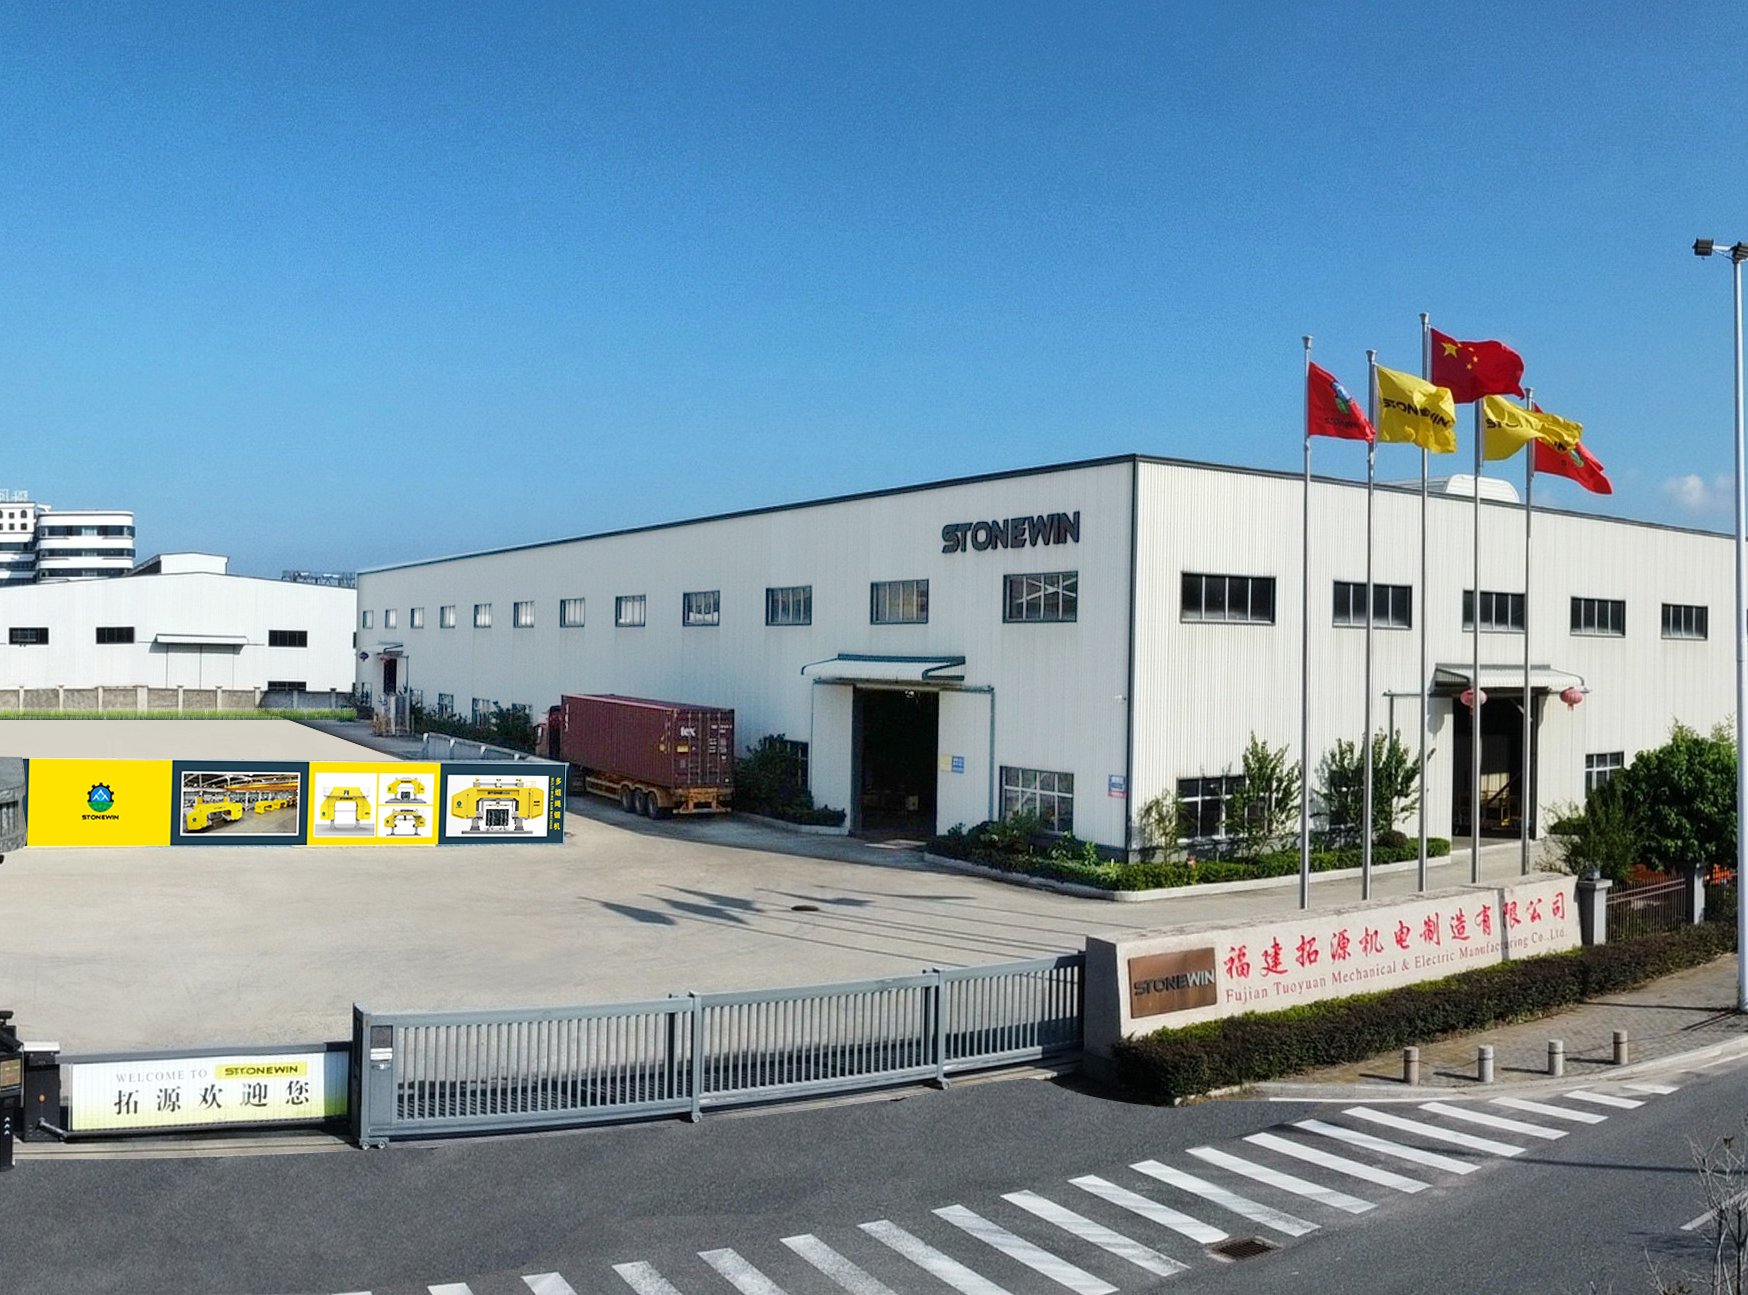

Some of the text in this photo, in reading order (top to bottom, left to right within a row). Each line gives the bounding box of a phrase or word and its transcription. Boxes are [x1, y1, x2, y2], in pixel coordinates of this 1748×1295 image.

[942, 511, 1080, 553] STONEWIN
[1224, 891, 1566, 980] 福建拓源机电制造有限公司
[1134, 969, 1215, 996] STONEWIN
[1226, 988, 1268, 1004] Fujian
[1273, 979, 1327, 994] Tuoyuan
[1331, 961, 1397, 985] Mechanical
[1401, 960, 1410, 971] &
[1414, 950, 1455, 969] Electric
[1459, 936, 1529, 959] Manufacturing
[116, 1069, 185, 1083] WELCOME
[191, 1069, 208, 1080] TO
[114, 1080, 310, 1115] 拓源欢迎您
